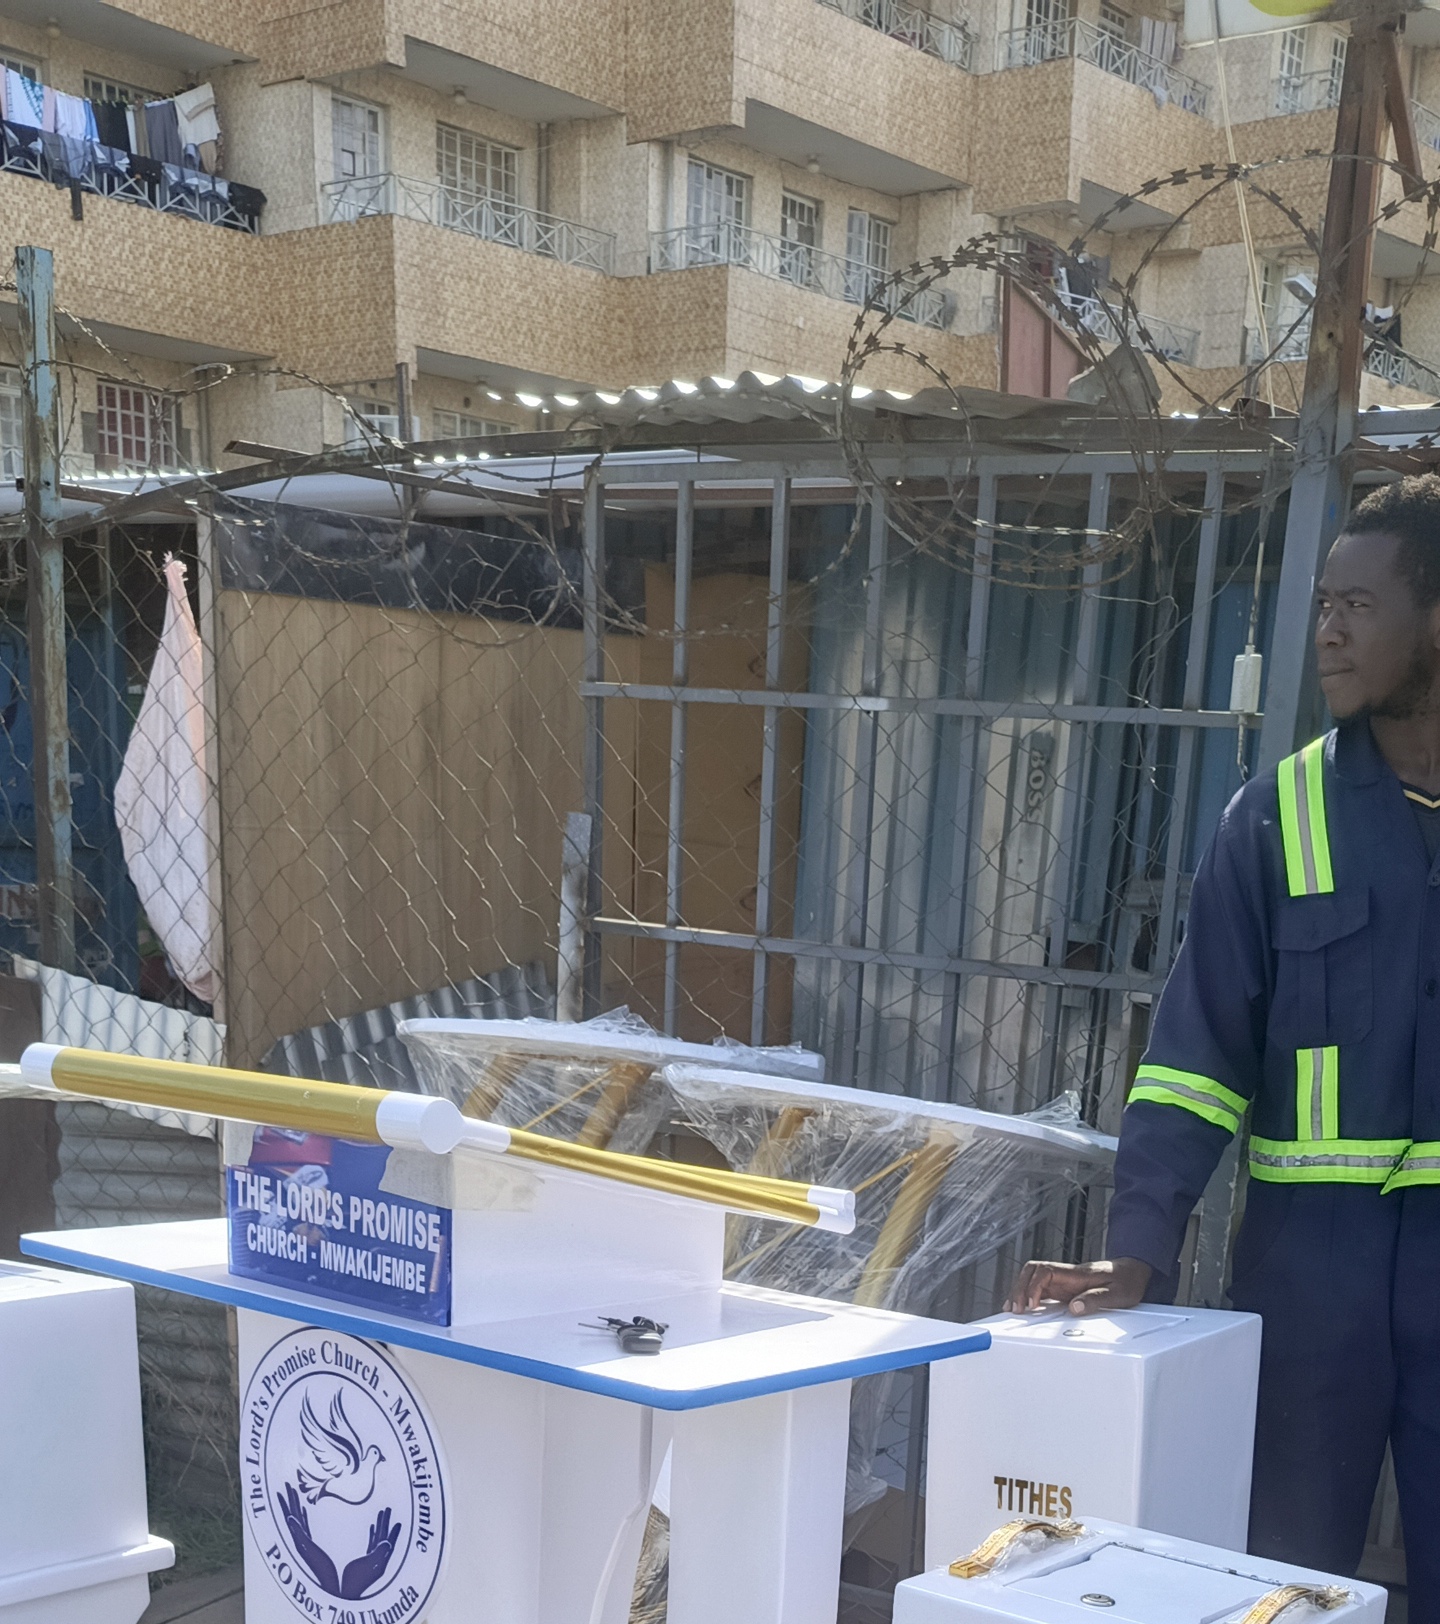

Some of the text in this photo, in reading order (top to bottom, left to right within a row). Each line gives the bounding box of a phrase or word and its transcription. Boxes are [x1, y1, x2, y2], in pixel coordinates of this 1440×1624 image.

[234, 1171, 441, 1253] THE LORD'S PROMISE
[247, 1223, 307, 1264] CHURCH
[320, 1240, 426, 1294] MWAKIJEMBE
[261, 1345, 317, 1397] Promise
[320, 1340, 379, 1391] Church
[246, 1396, 270, 1467] Lord's
[250, 1474, 267, 1519] The
[389, 1395, 434, 1553] Mwakijembe
[993, 1475, 1072, 1519] TITHES
[265, 1542, 293, 1585] P.O
[292, 1578, 324, 1621] Box
